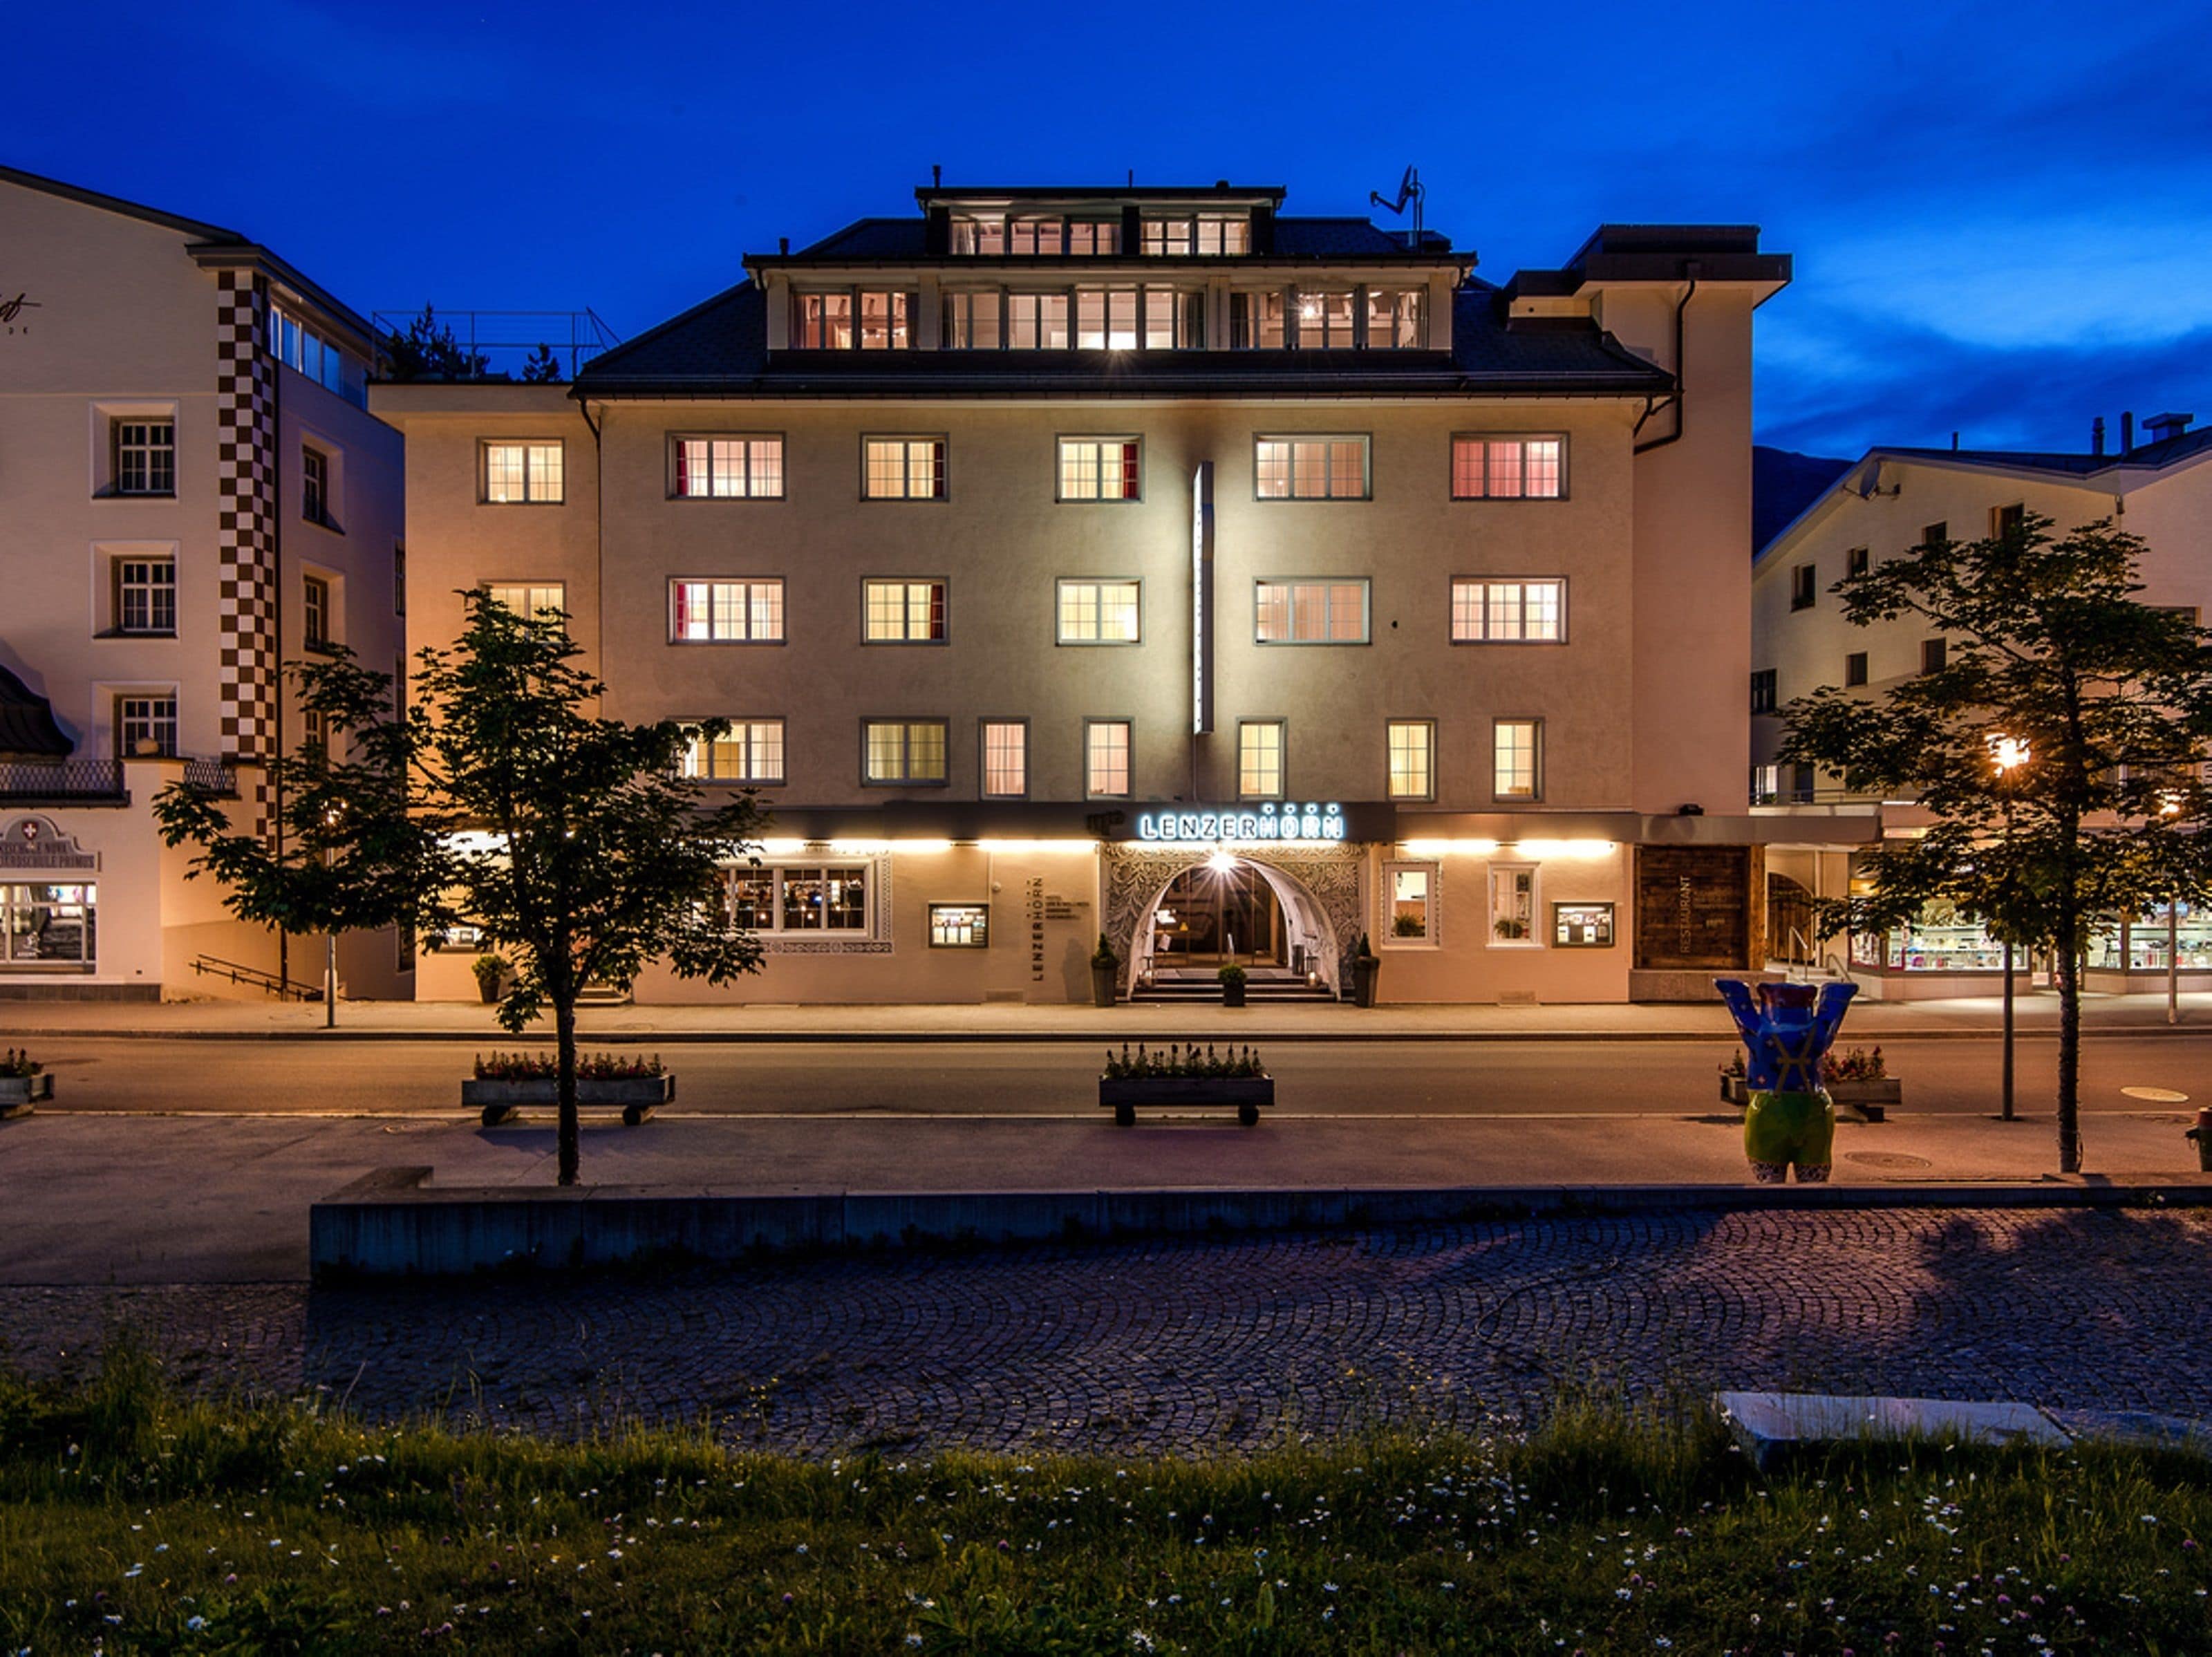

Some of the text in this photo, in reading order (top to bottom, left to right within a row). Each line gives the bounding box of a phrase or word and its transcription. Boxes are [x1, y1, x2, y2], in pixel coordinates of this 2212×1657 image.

[1141, 815, 1343, 839] LENZERHORN
[1032, 877, 1044, 981] LENZERHORN
[1680, 874, 1691, 953] RESTAURANT
